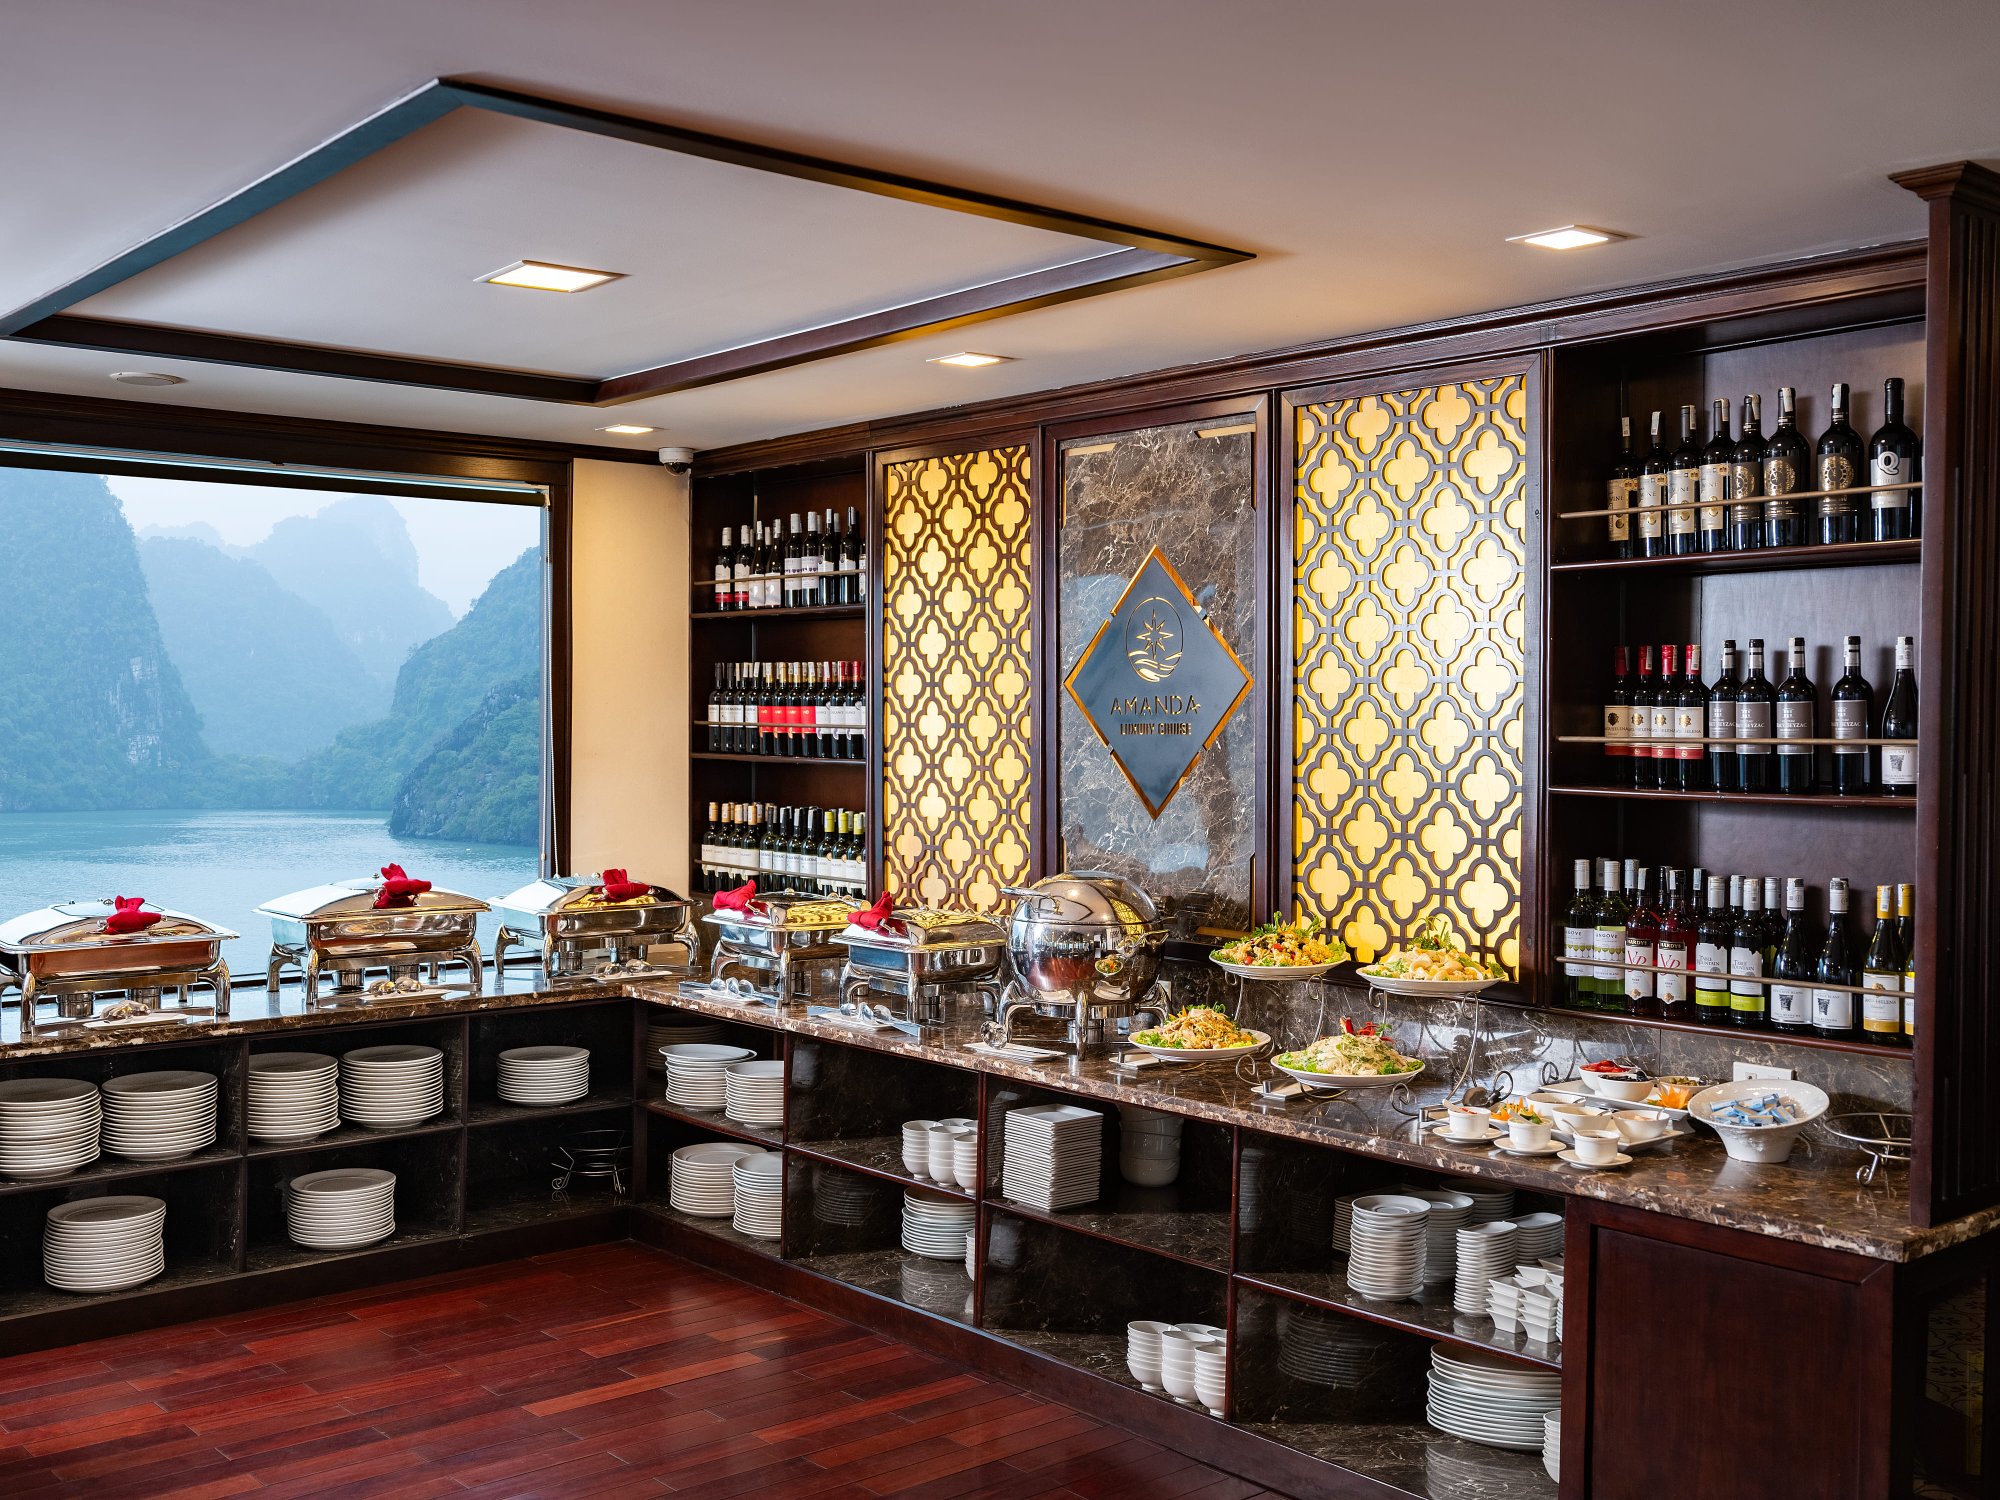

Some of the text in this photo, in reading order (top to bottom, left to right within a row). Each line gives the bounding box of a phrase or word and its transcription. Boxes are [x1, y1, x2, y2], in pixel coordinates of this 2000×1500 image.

[1877, 451, 1900, 475] Q
[1110, 694, 1201, 716] AMANDA
[1120, 722, 1192, 736] LUXURY CRUISE
